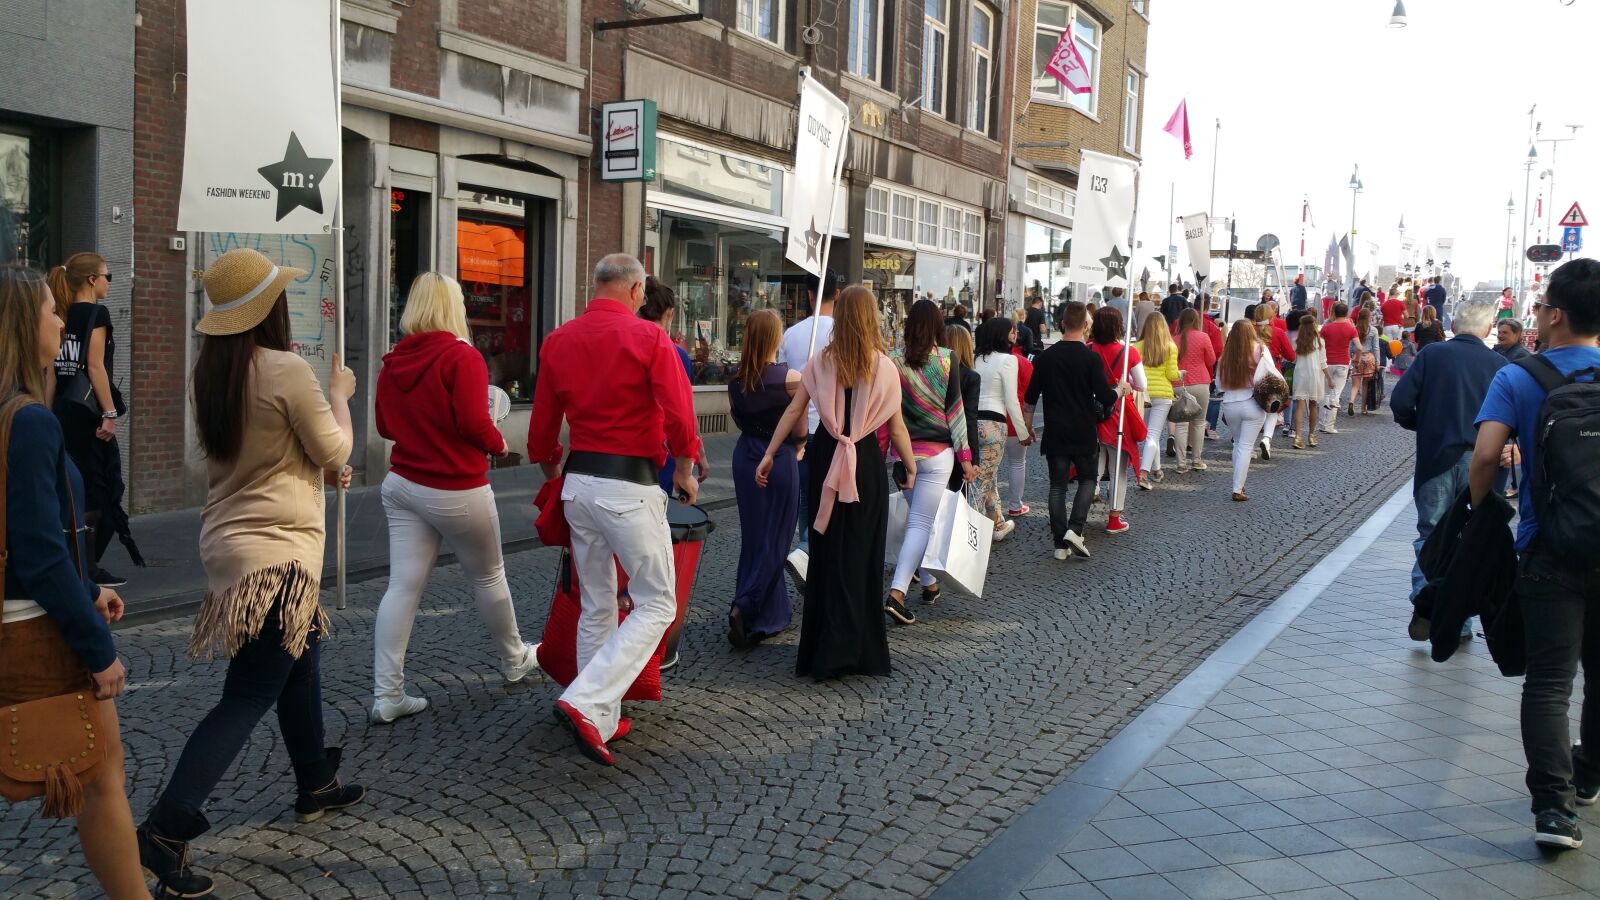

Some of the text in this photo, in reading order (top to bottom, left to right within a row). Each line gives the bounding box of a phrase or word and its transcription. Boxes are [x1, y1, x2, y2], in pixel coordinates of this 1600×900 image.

[1090, 174, 1108, 194] 133
[206, 187, 271, 200] FASHION WEEKEND
[1185, 227, 1204, 240] BASLER
